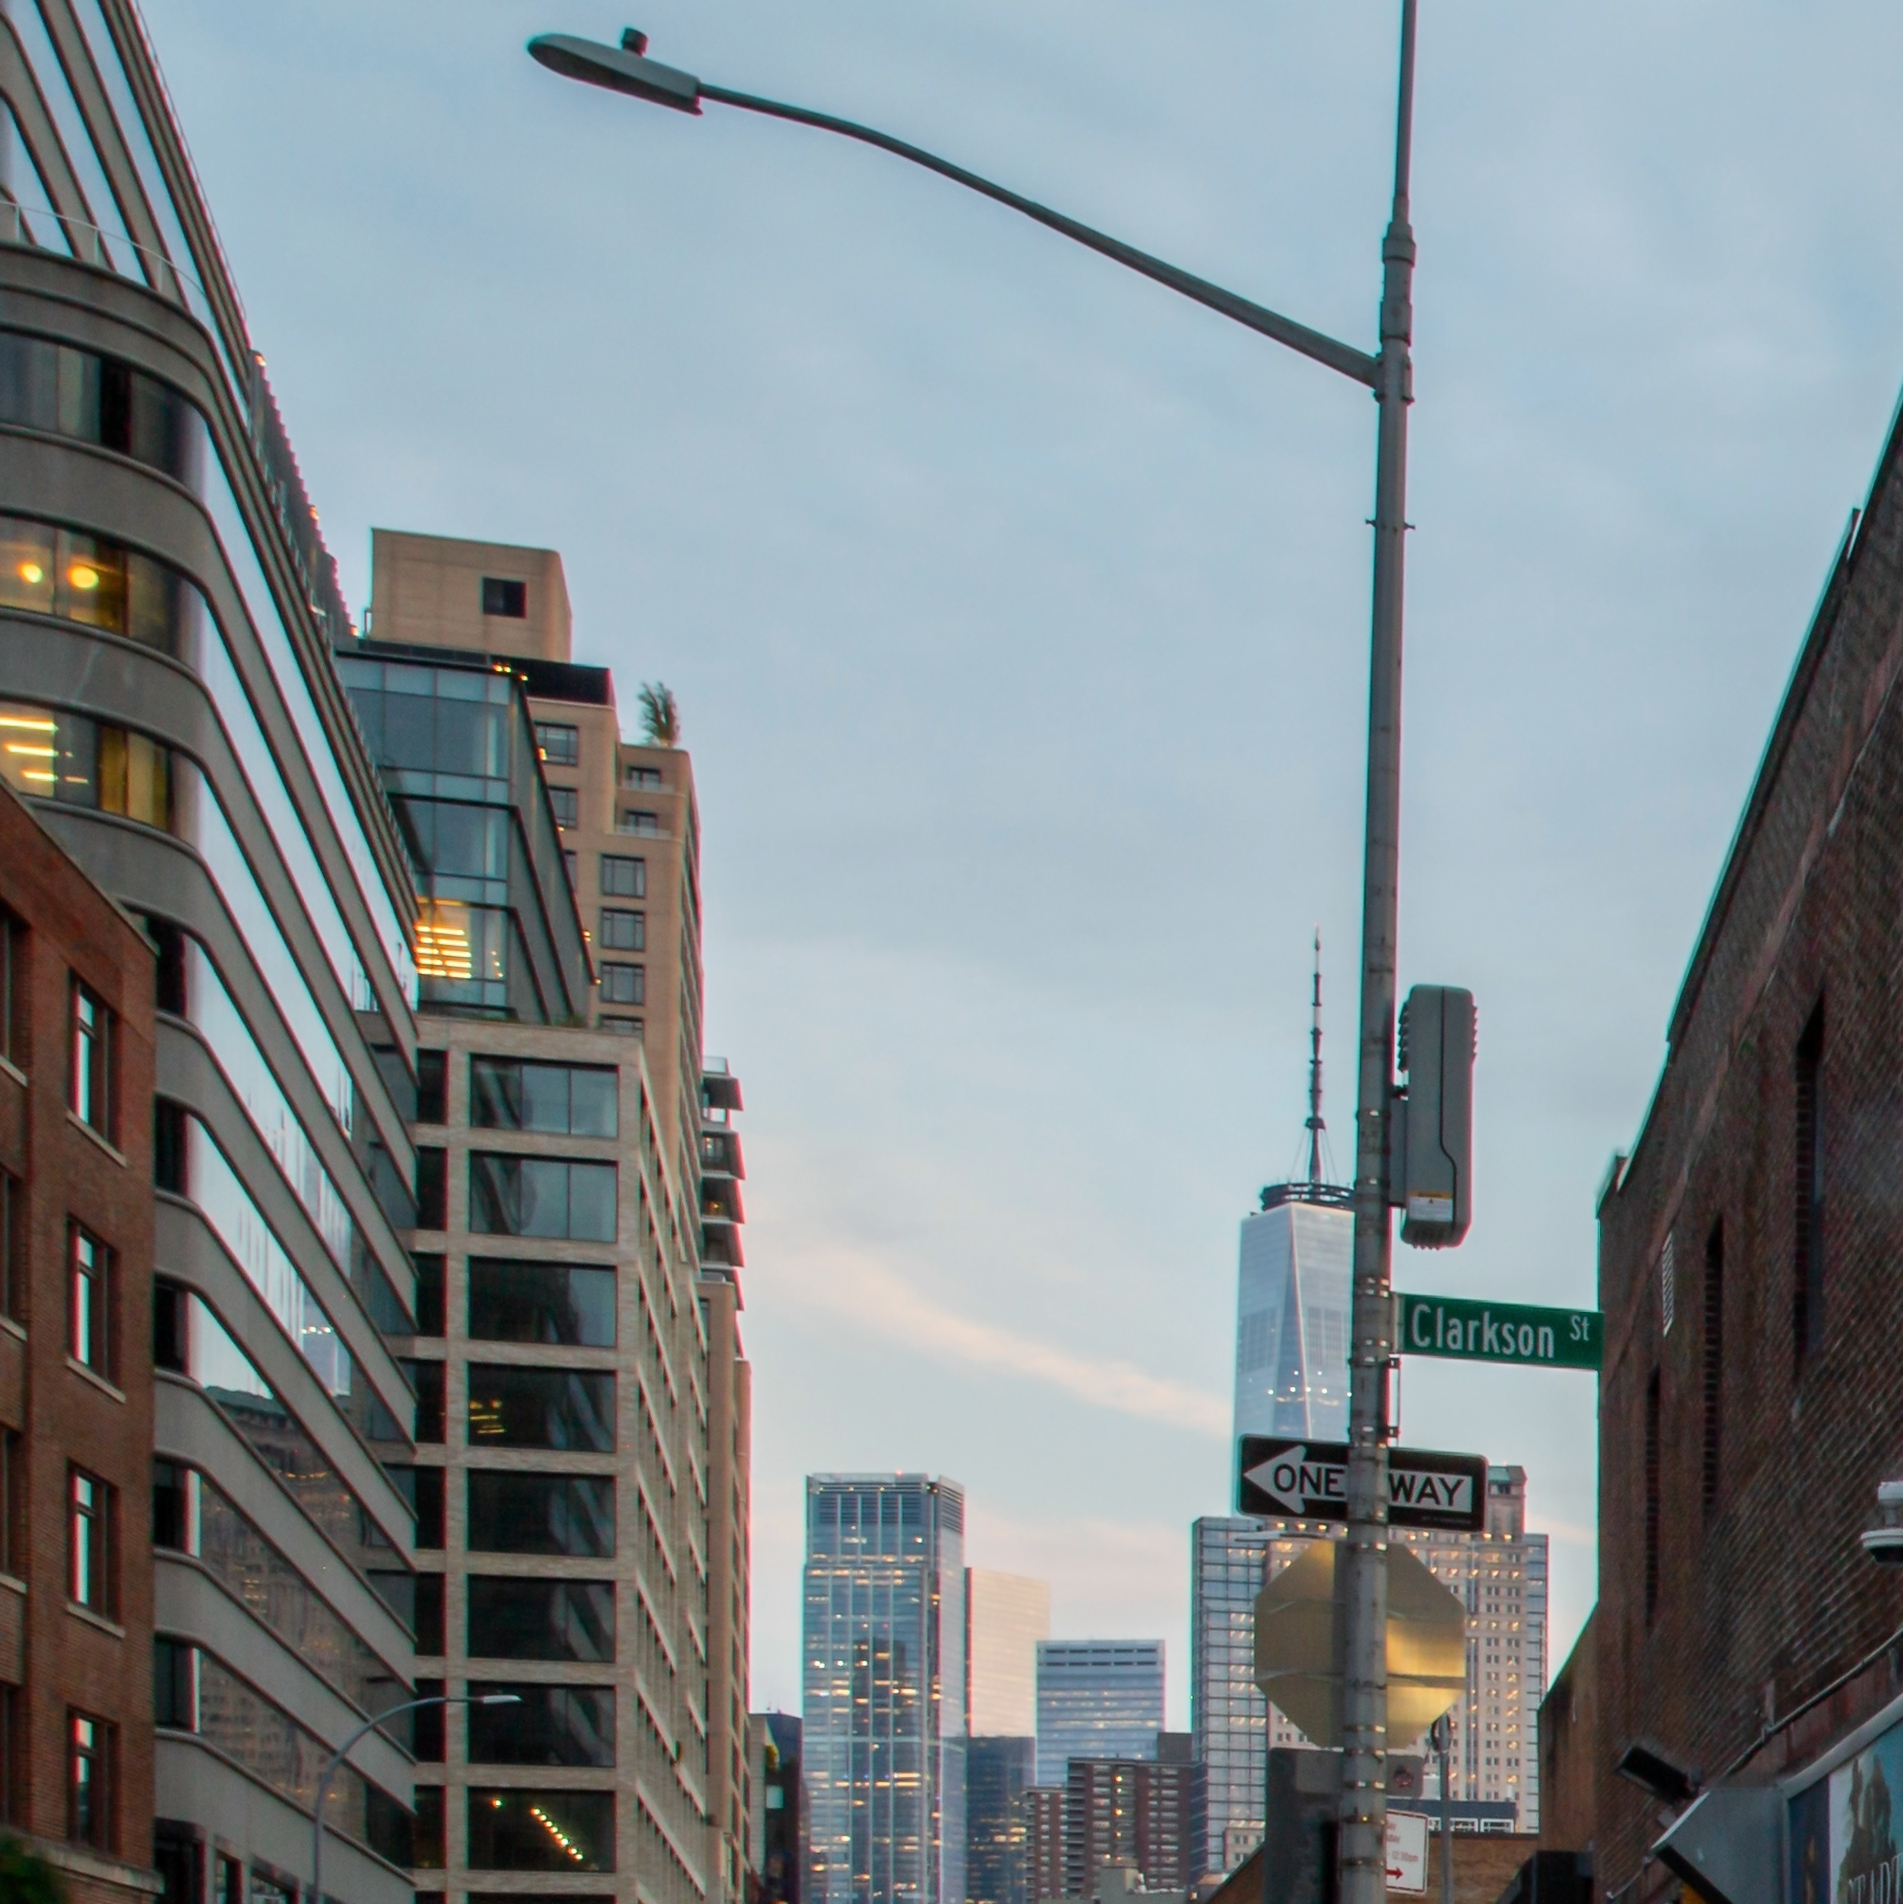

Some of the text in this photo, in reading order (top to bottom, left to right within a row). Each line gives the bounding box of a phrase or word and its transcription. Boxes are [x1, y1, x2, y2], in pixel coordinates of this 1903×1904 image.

[1411, 1303, 1591, 1359] Clarkson St
[1273, 1463, 1466, 1507] ONE WAY
